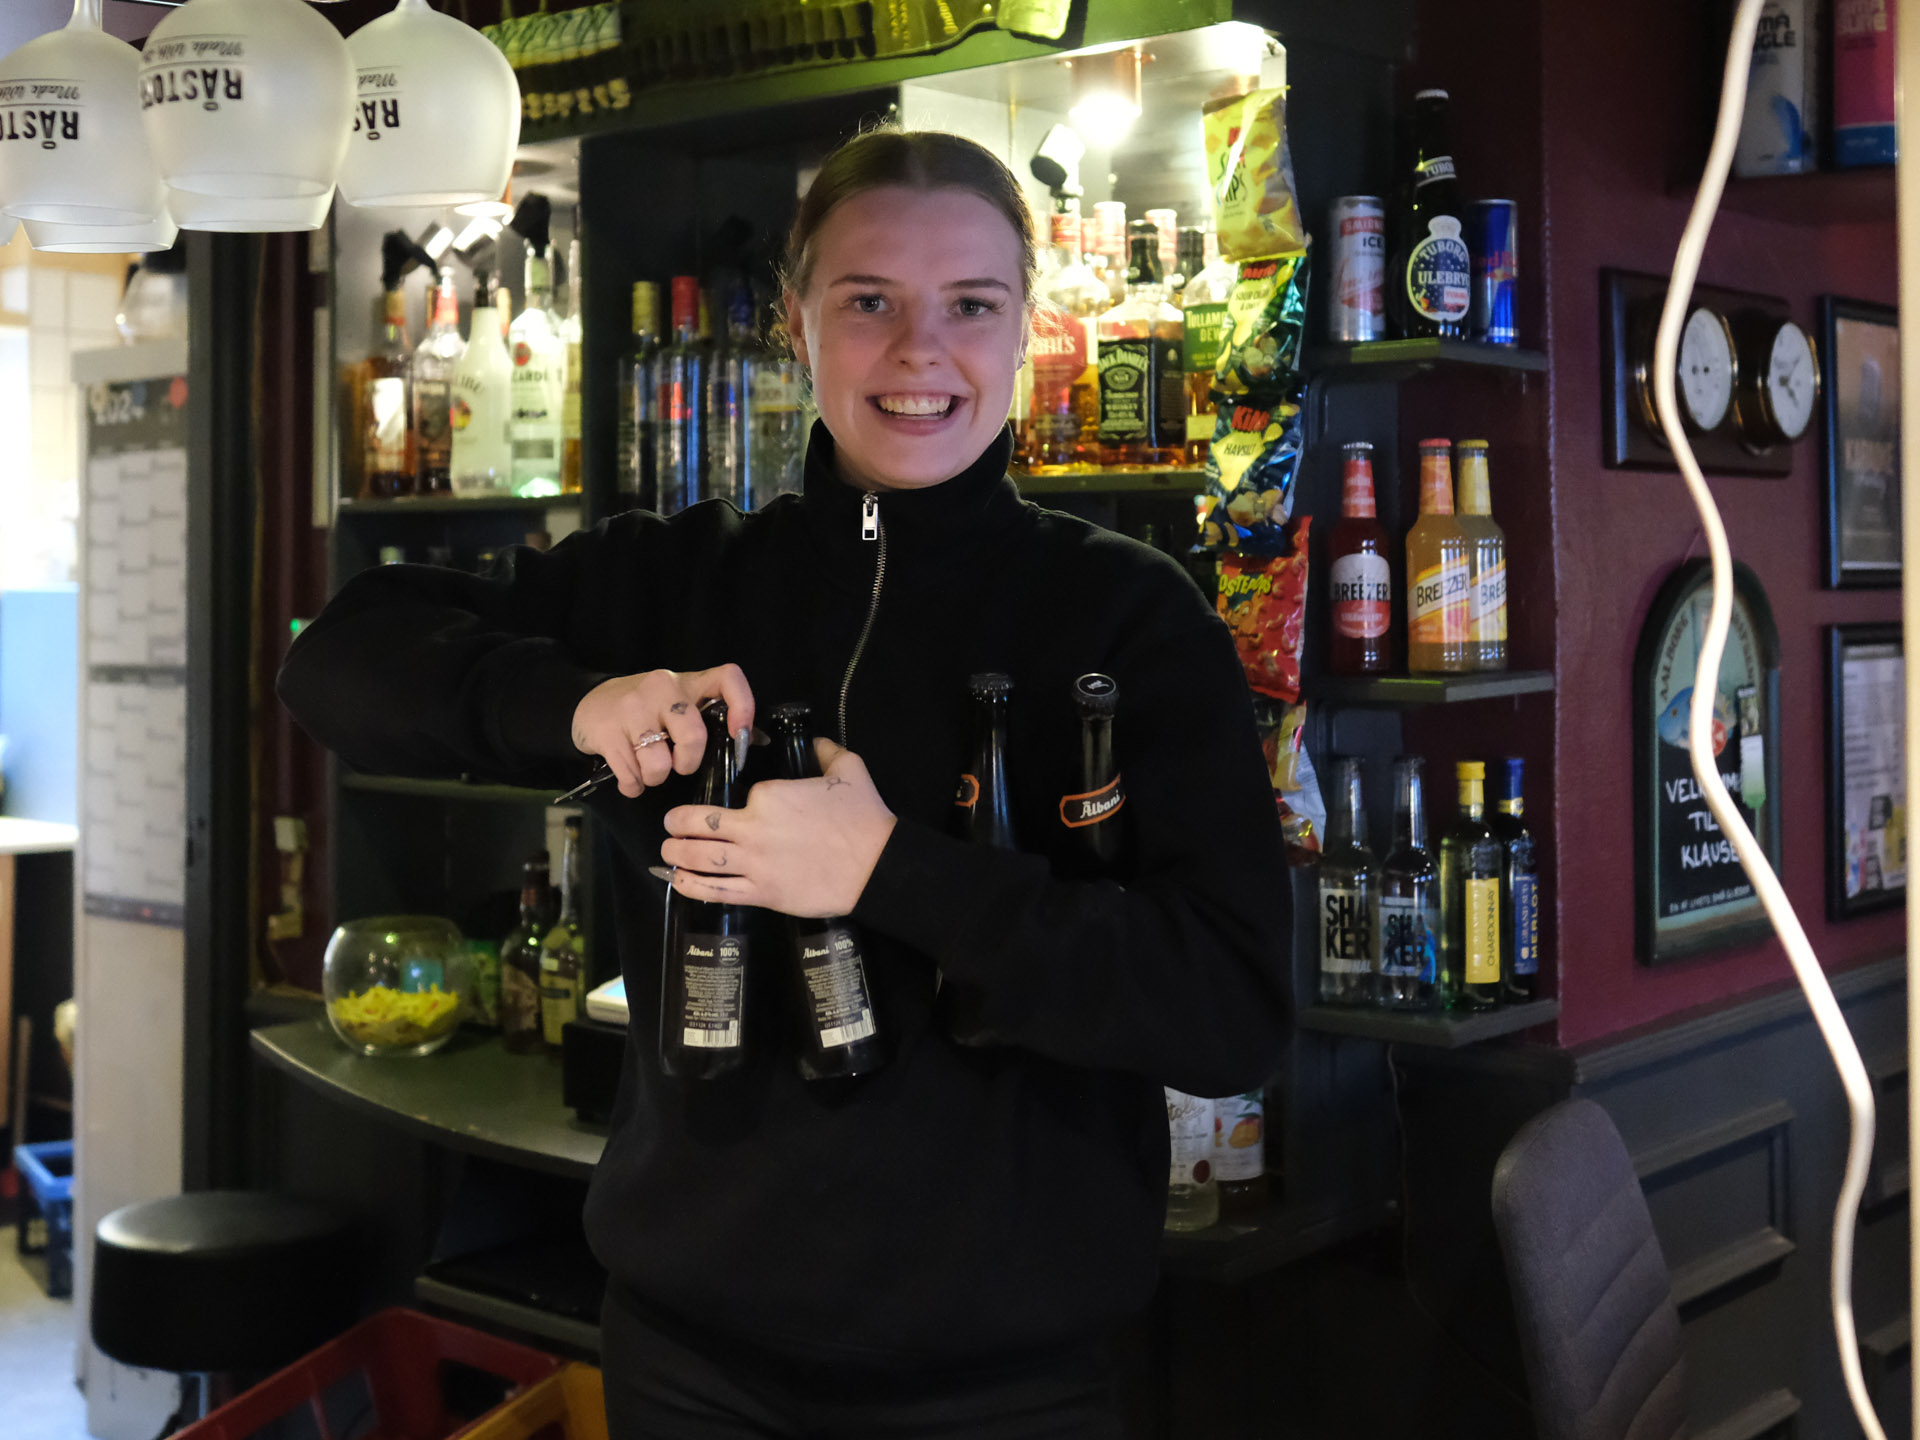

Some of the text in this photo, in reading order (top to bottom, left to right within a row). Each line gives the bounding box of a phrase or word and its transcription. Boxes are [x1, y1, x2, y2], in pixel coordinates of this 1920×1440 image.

[1420, 239, 1468, 262] TUBORG
[1334, 582, 1389, 601] BREEZER
[1416, 572, 1468, 609] BREEZER
[1080, 790, 1121, 820] Albani
[1487, 888, 1495, 967] CHARDONNAY
[719, 947, 739, 957] 100%
[834, 939, 855, 951] 100%
